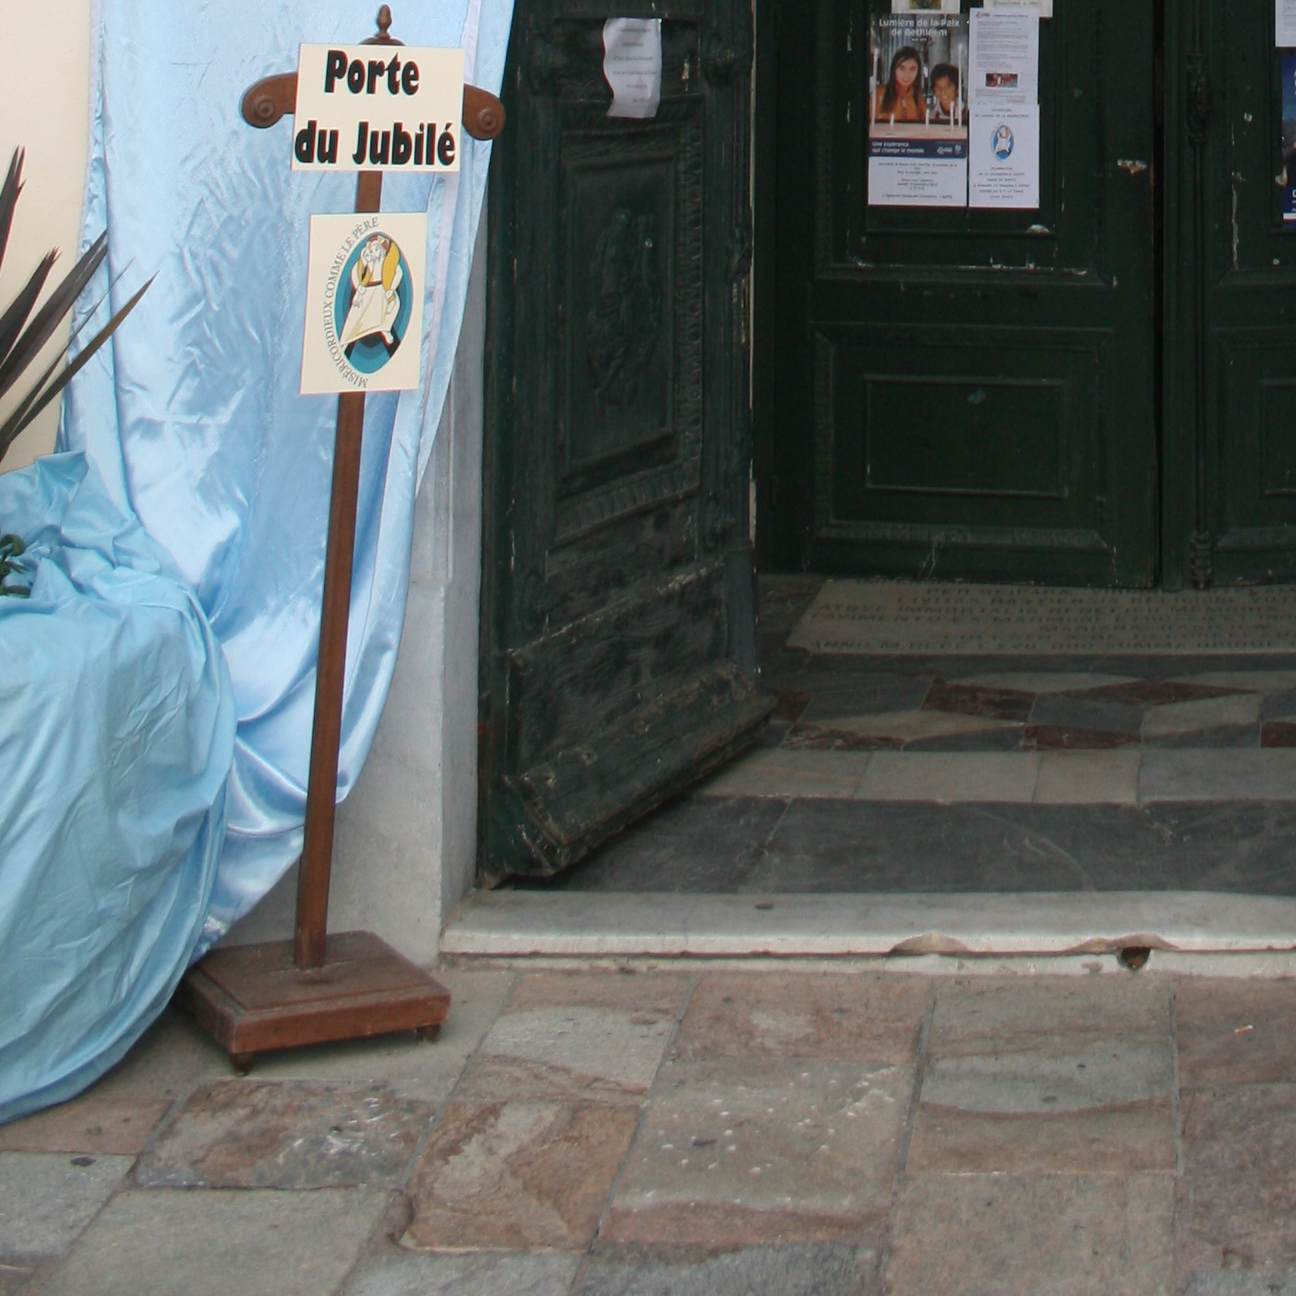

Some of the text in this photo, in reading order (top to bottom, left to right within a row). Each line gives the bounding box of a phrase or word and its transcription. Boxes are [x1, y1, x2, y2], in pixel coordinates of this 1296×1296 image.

[879, 18, 914, 27] Lumière
[916, 18, 928, 27] de
[940, 18, 960, 26] Paix
[891, 27, 948, 36] de Bethléem
[323, 49, 420, 96] Porte
[294, 119, 456, 167] du Jubilé
[323, 216, 380, 389] MISÉRICORDIEUX COMME LE PÈRE
